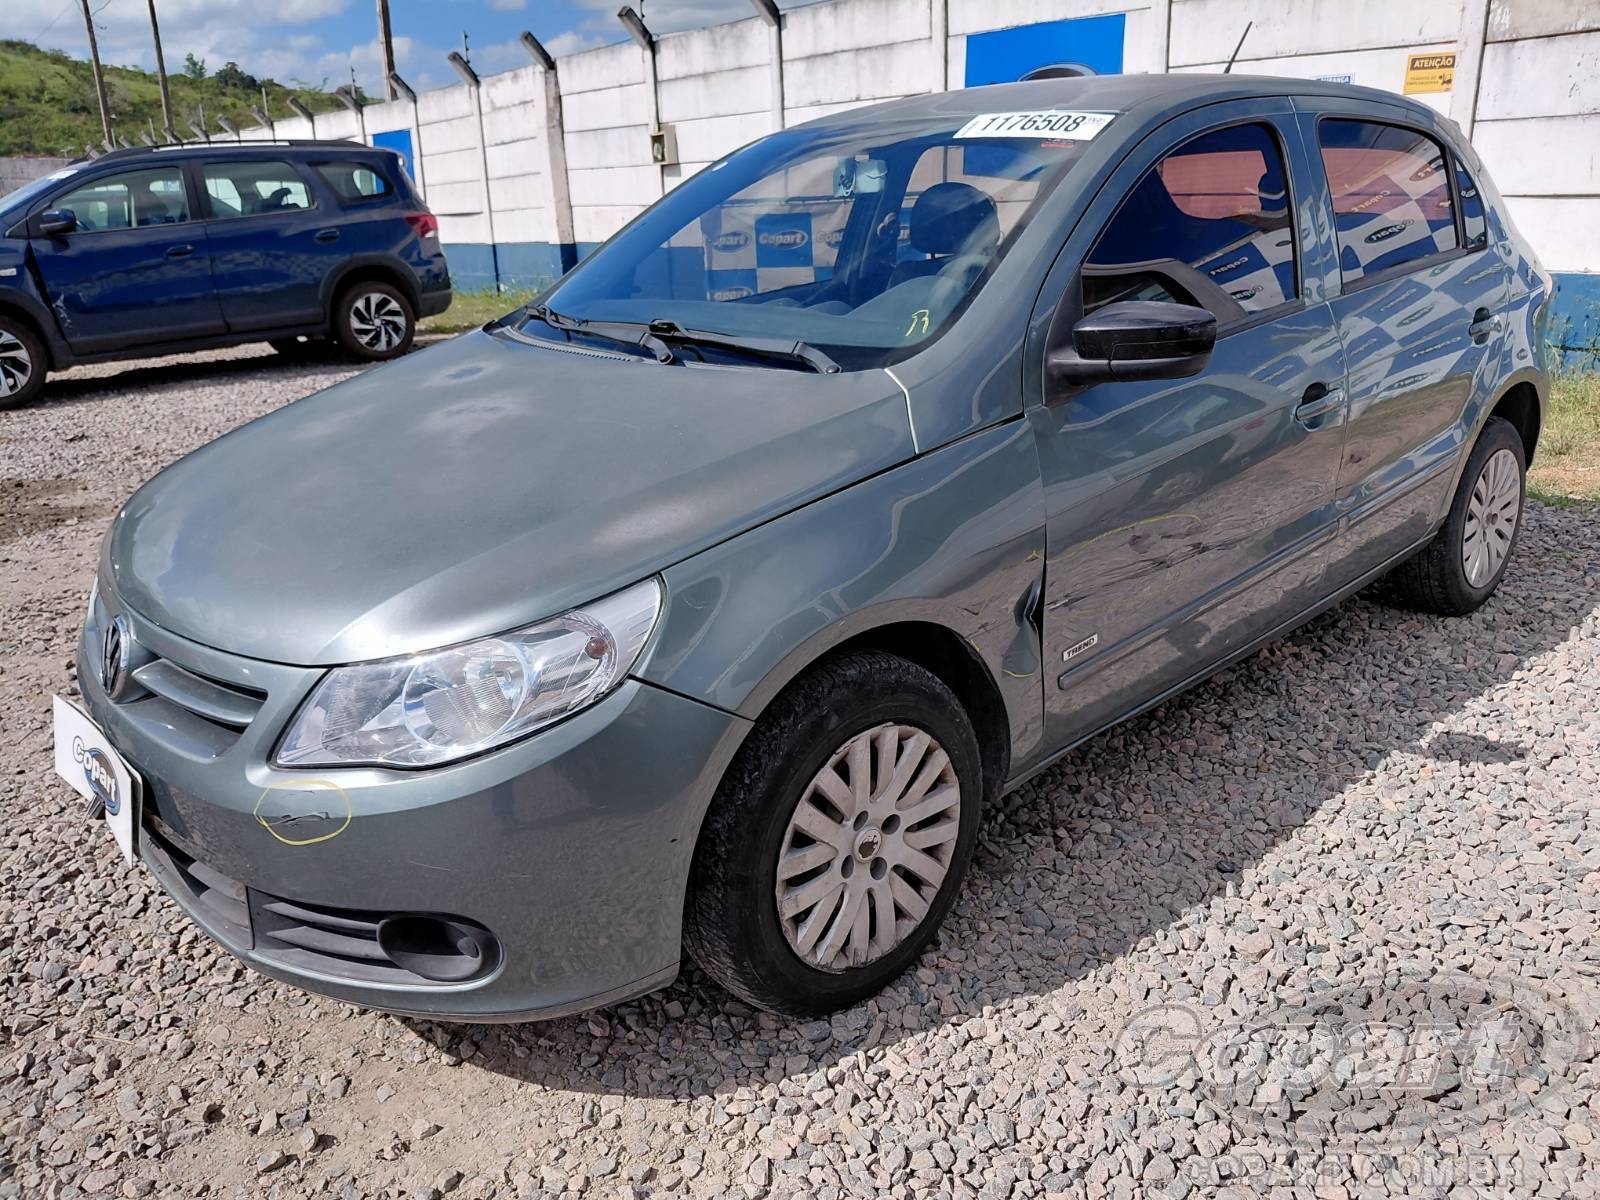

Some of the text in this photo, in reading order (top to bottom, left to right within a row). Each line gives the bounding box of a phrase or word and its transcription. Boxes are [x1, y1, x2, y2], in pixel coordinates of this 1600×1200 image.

[1413, 57, 1453, 68] ATENÇÃO
[981, 115, 1087, 132] 1176508
[759, 232, 803, 247] Copart
[1067, 637, 1095, 657] TREND
[73, 735, 116, 804] Copart
